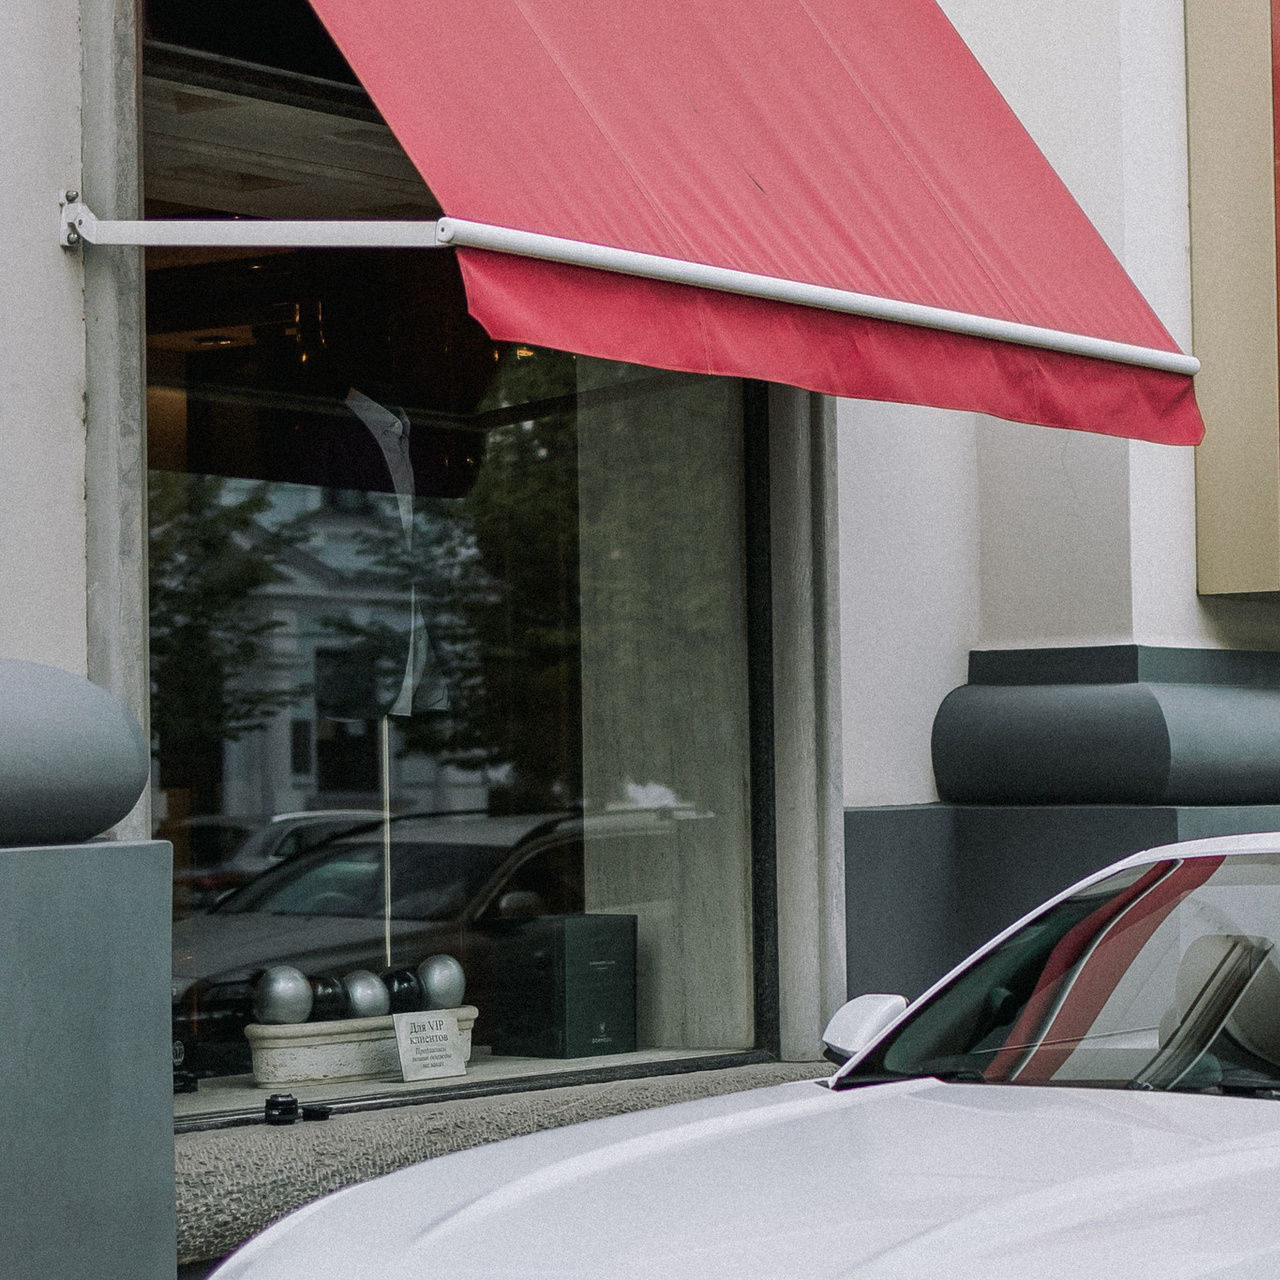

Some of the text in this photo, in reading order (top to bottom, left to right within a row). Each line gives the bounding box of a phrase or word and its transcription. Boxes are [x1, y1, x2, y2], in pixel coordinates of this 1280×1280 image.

[410, 1020, 444, 1034] Для VIP
[410, 1034, 449, 1044] клиентов
